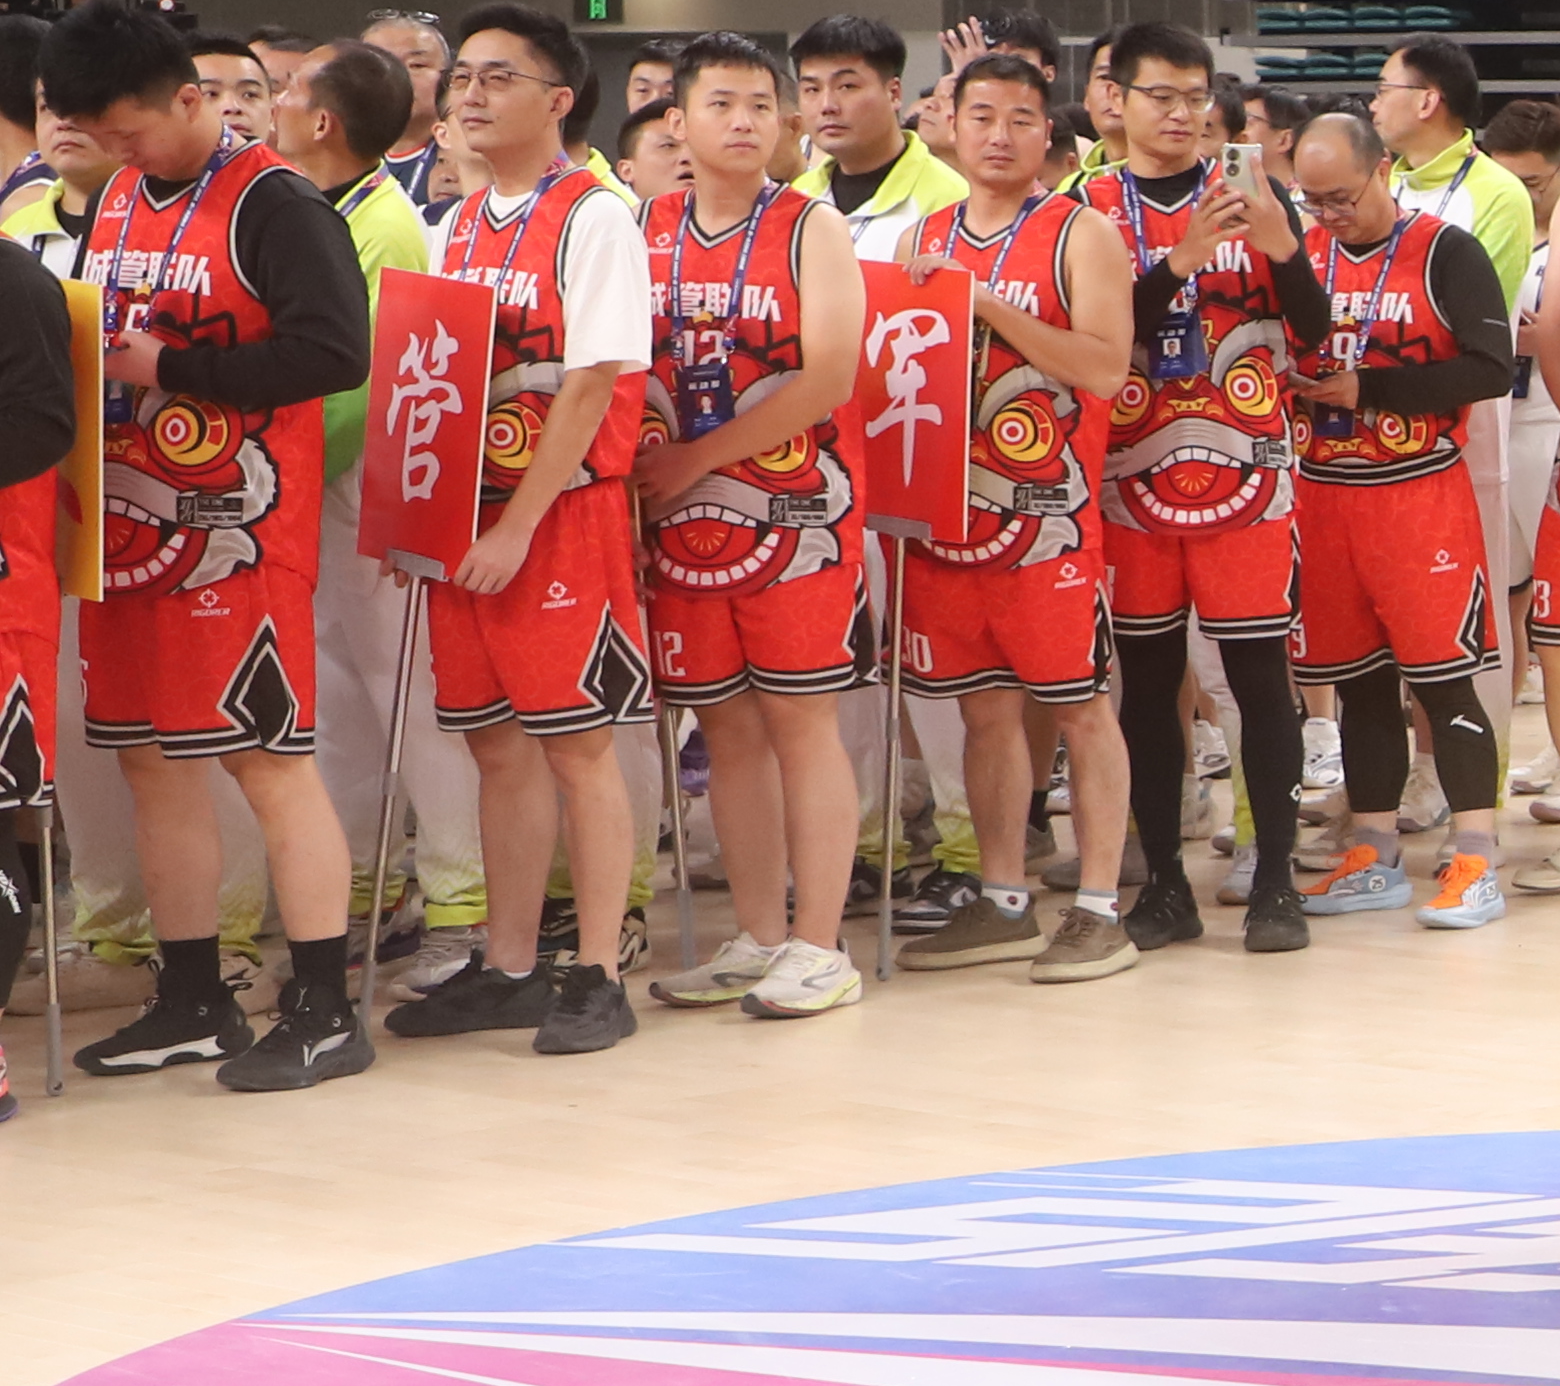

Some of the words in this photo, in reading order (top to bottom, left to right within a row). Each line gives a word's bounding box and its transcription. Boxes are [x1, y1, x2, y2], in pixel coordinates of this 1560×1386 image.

[1331, 292, 1413, 324] 管联队
[865, 308, 951, 488] 军
